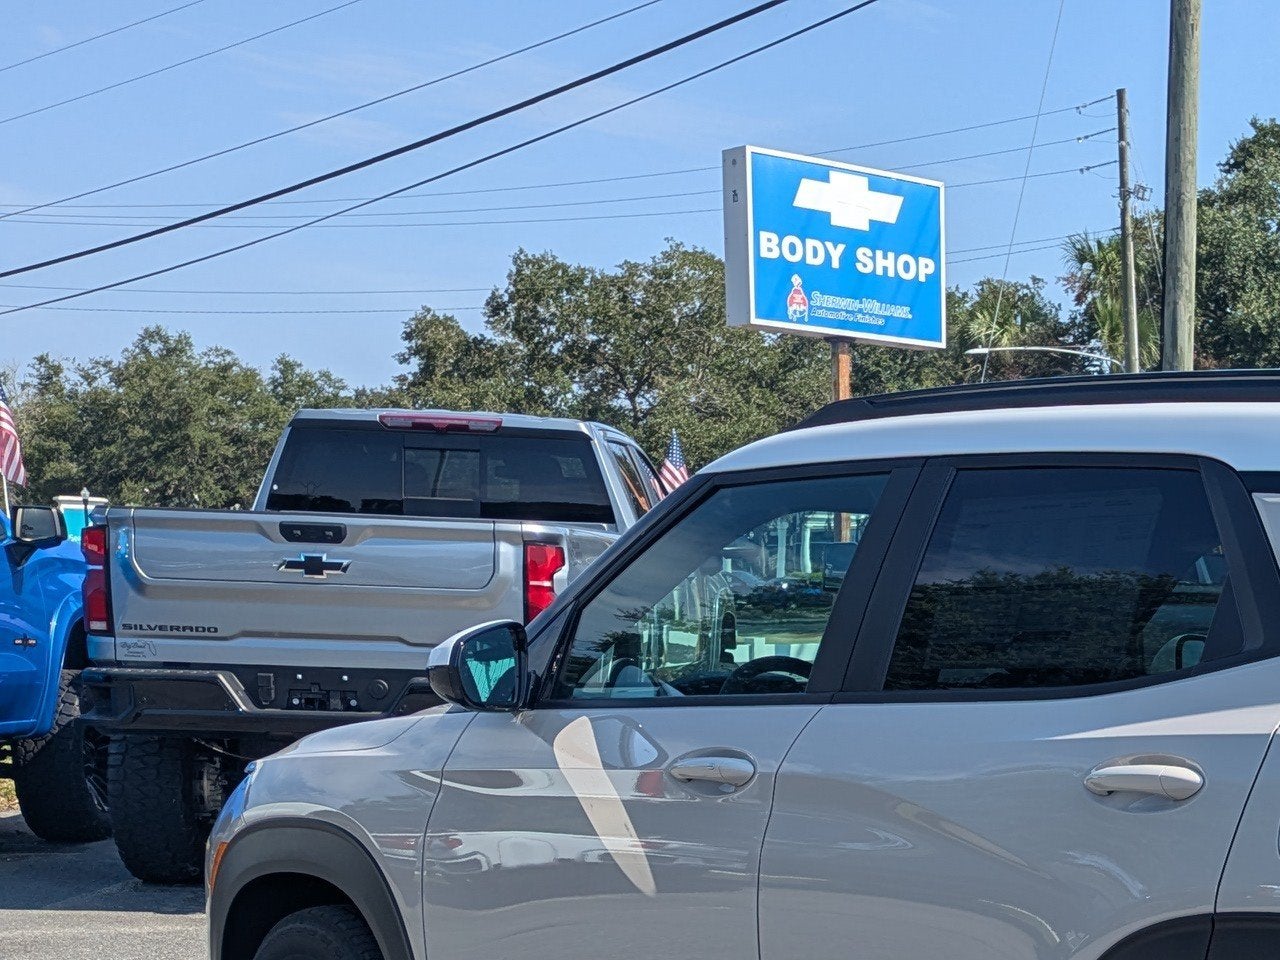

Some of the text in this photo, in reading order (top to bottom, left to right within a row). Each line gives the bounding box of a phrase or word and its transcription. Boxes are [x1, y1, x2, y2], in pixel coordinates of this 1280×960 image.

[759, 230, 936, 282] BODY SHOP
[810, 307, 886, 326] Automotive Finishes
[121, 623, 219, 634] SILVERADO
